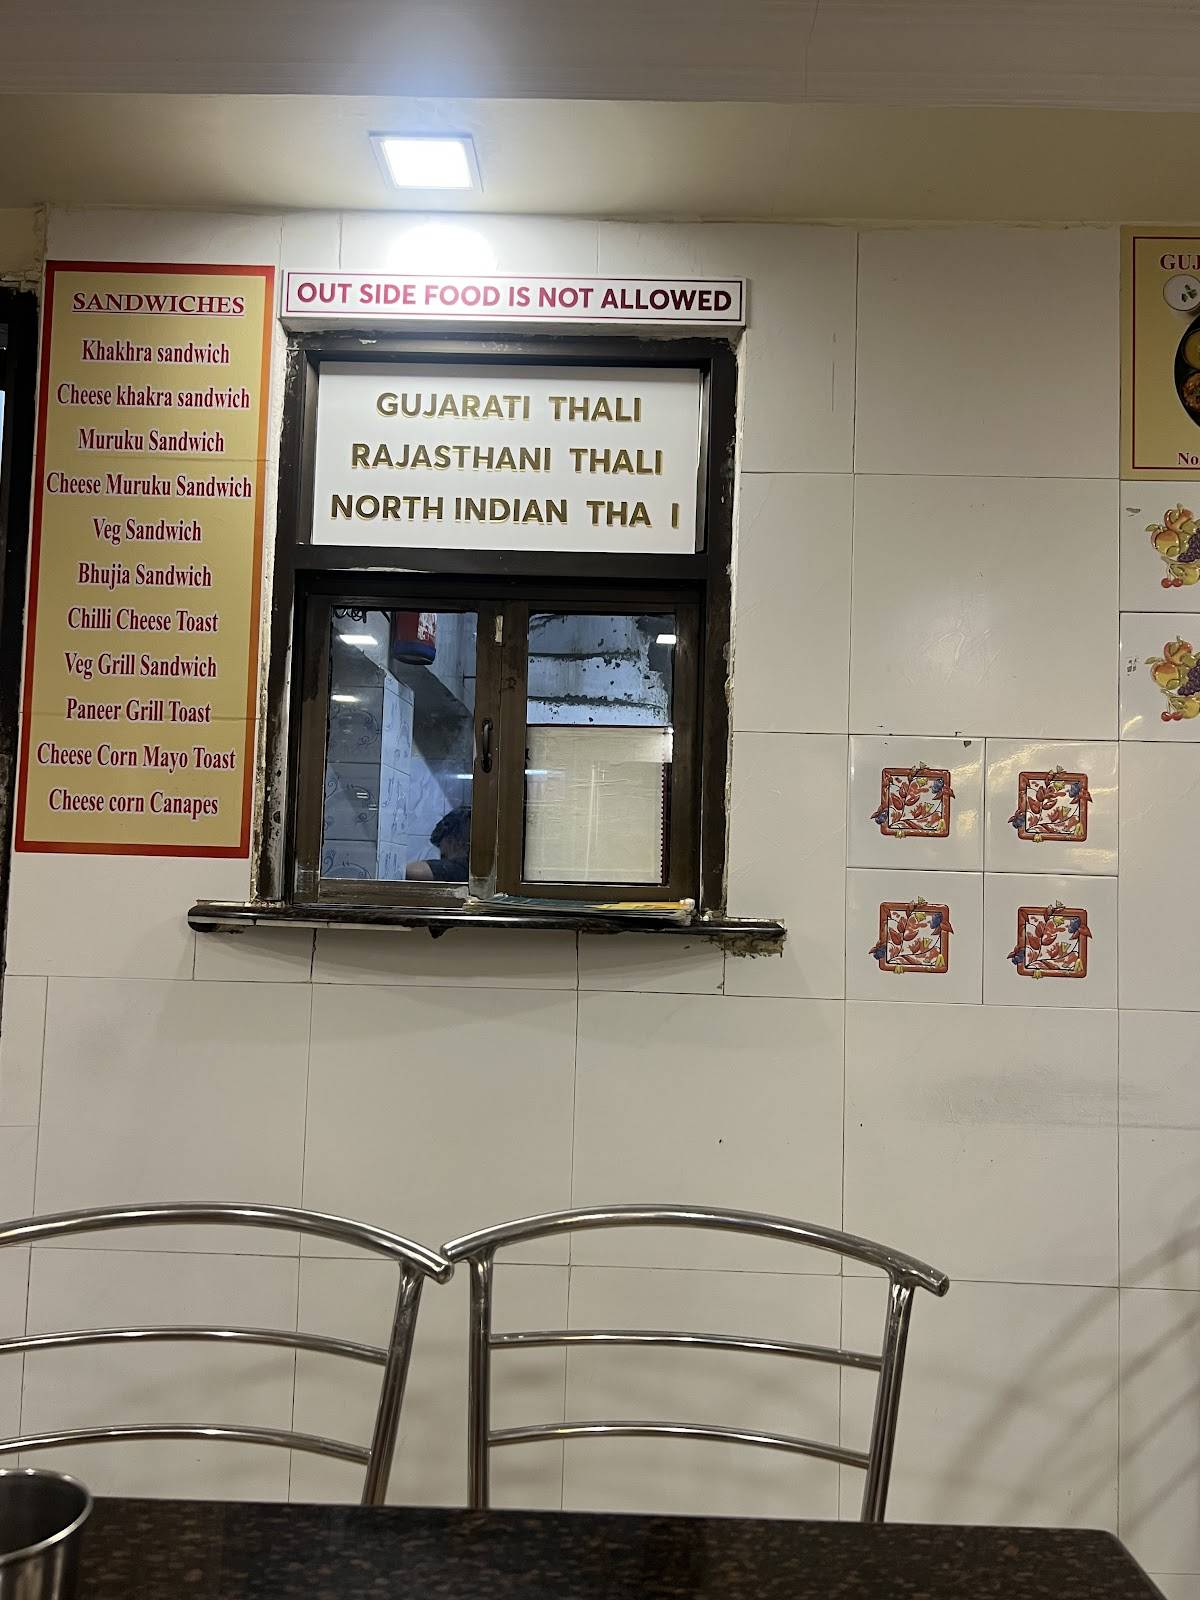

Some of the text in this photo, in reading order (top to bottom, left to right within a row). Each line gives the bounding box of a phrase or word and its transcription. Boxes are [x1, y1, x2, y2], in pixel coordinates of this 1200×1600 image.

[73, 293, 244, 314] SANDWICHES
[298, 282, 732, 311] OUT SIDE FOOD IS NOT ALLOWED
[82, 340, 229, 363] Khakhra sandwich
[57, 384, 250, 408] Cheese khakra sandwich
[376, 392, 641, 422] GUJARATI THALI
[79, 429, 224, 451] Muruku Sandwich
[352, 443, 663, 475] RAJASTHANI THALI
[47, 472, 252, 497] Cheese Muruku Sandwich
[331, 494, 443, 522] NORTH
[455, 497, 568, 524] INDIAN
[93, 518, 201, 544] Veg Sandwich
[78, 563, 212, 589] Bhujia Sandwich
[68, 607, 218, 632] Chilli Cheese Toast
[64, 653, 217, 678] Veg Grill Sandwich
[66, 698, 211, 722] Paneer Grill Toast
[37, 743, 236, 773] Cheese Corn Mayo Toast
[49, 789, 218, 819] Cheese corn Canapes
